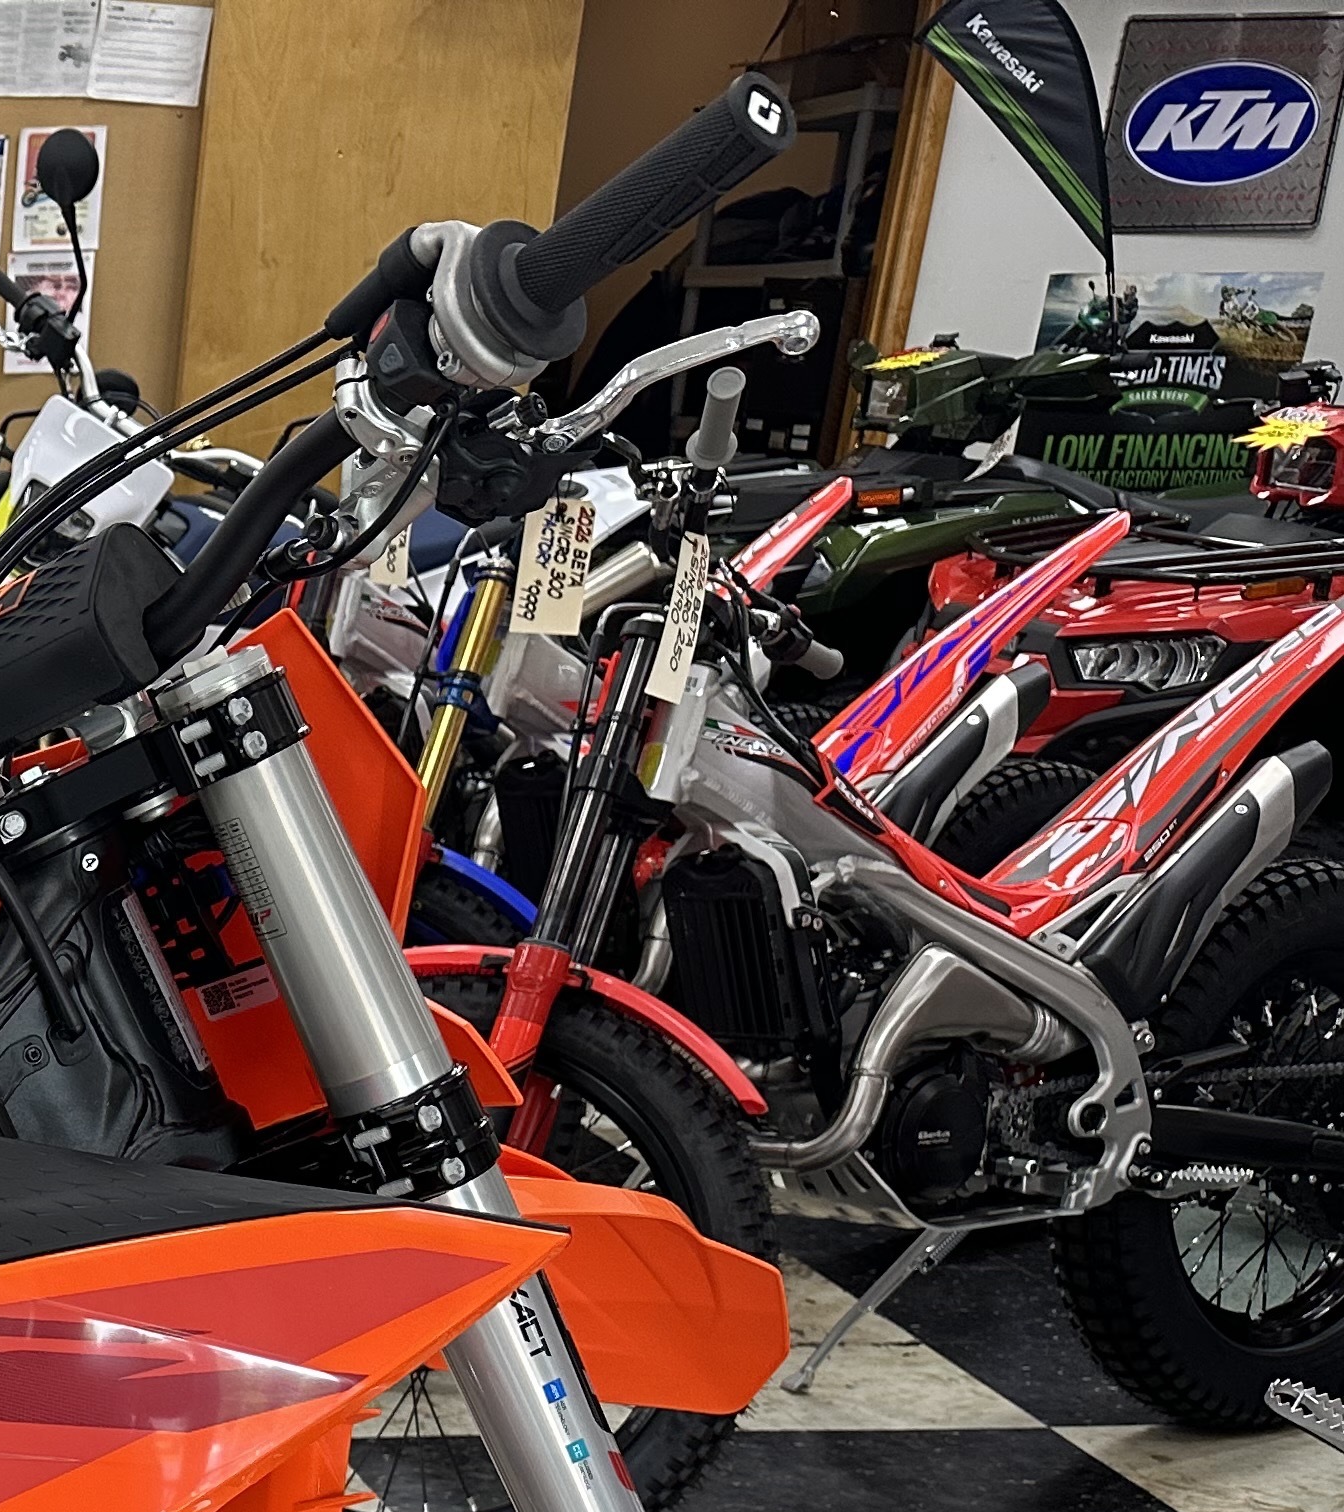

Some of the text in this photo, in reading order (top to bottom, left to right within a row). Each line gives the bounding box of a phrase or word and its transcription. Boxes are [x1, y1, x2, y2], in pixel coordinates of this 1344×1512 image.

[966, 13, 1045, 94] Kawasaki
[1134, 89, 1311, 152] KTM
[1149, 333, 1195, 344] Kawasaki
[1168, 354, 1227, 390] TIMES
[1128, 388, 1190, 402] SALES EVENT
[1042, 433, 1251, 469] LOW FINANCING
[1110, 469, 1168, 488] FACTORY
[546, 516, 576, 600] SINCRO 300
[567, 506, 596, 588] 2026 BETA
[669, 554, 700, 672] SINCRO 250
[685, 595, 702, 648] BETA
[1142, 829, 1172, 863] 250
